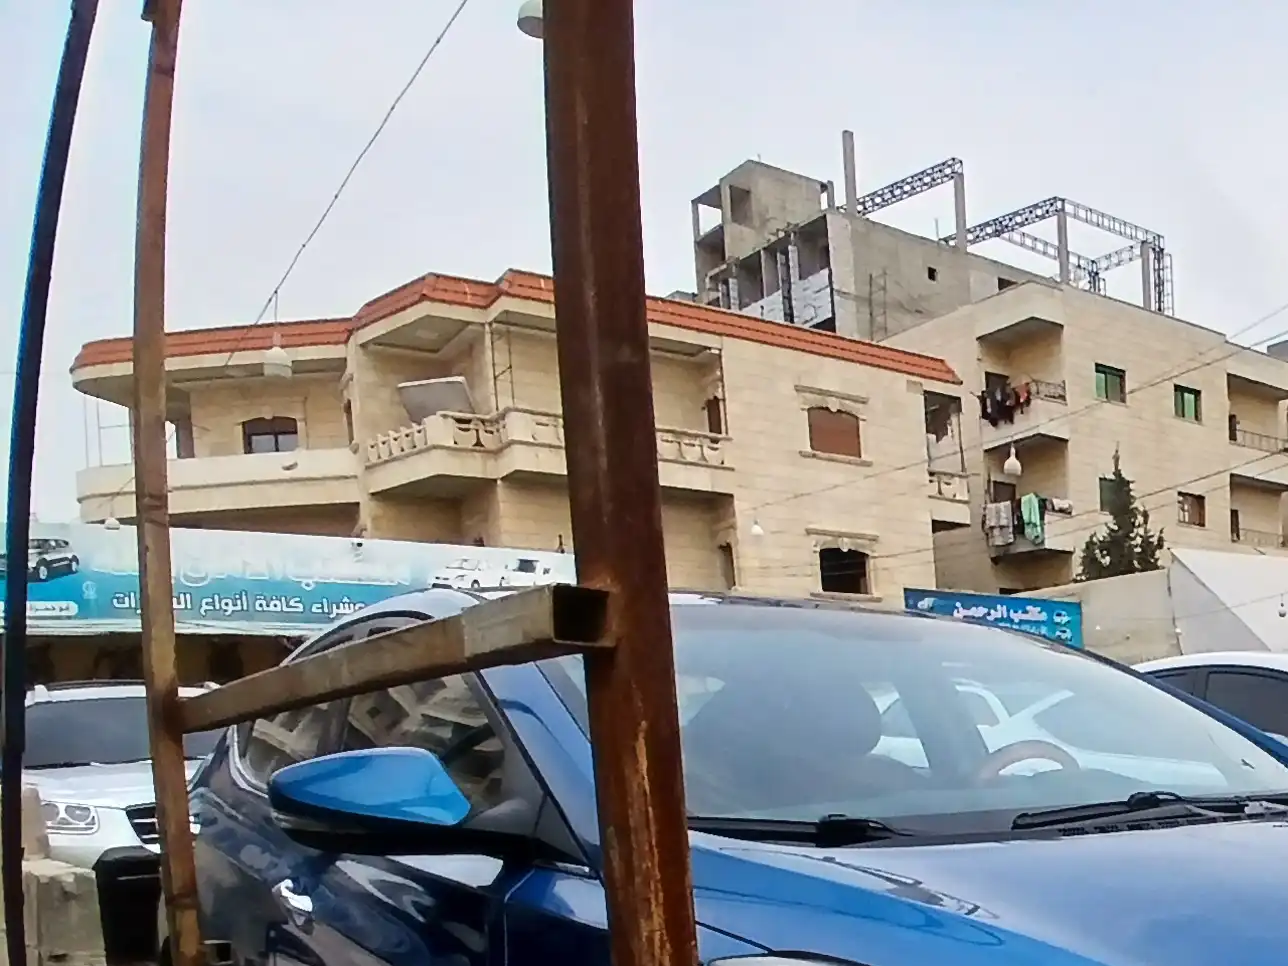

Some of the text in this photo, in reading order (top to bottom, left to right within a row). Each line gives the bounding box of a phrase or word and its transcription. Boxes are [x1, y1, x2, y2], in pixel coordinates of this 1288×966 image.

[199, 591, 248, 616] أنواع
[254, 596, 304, 613] كافة
[952, 600, 1049, 623] مكتب الرحمن
